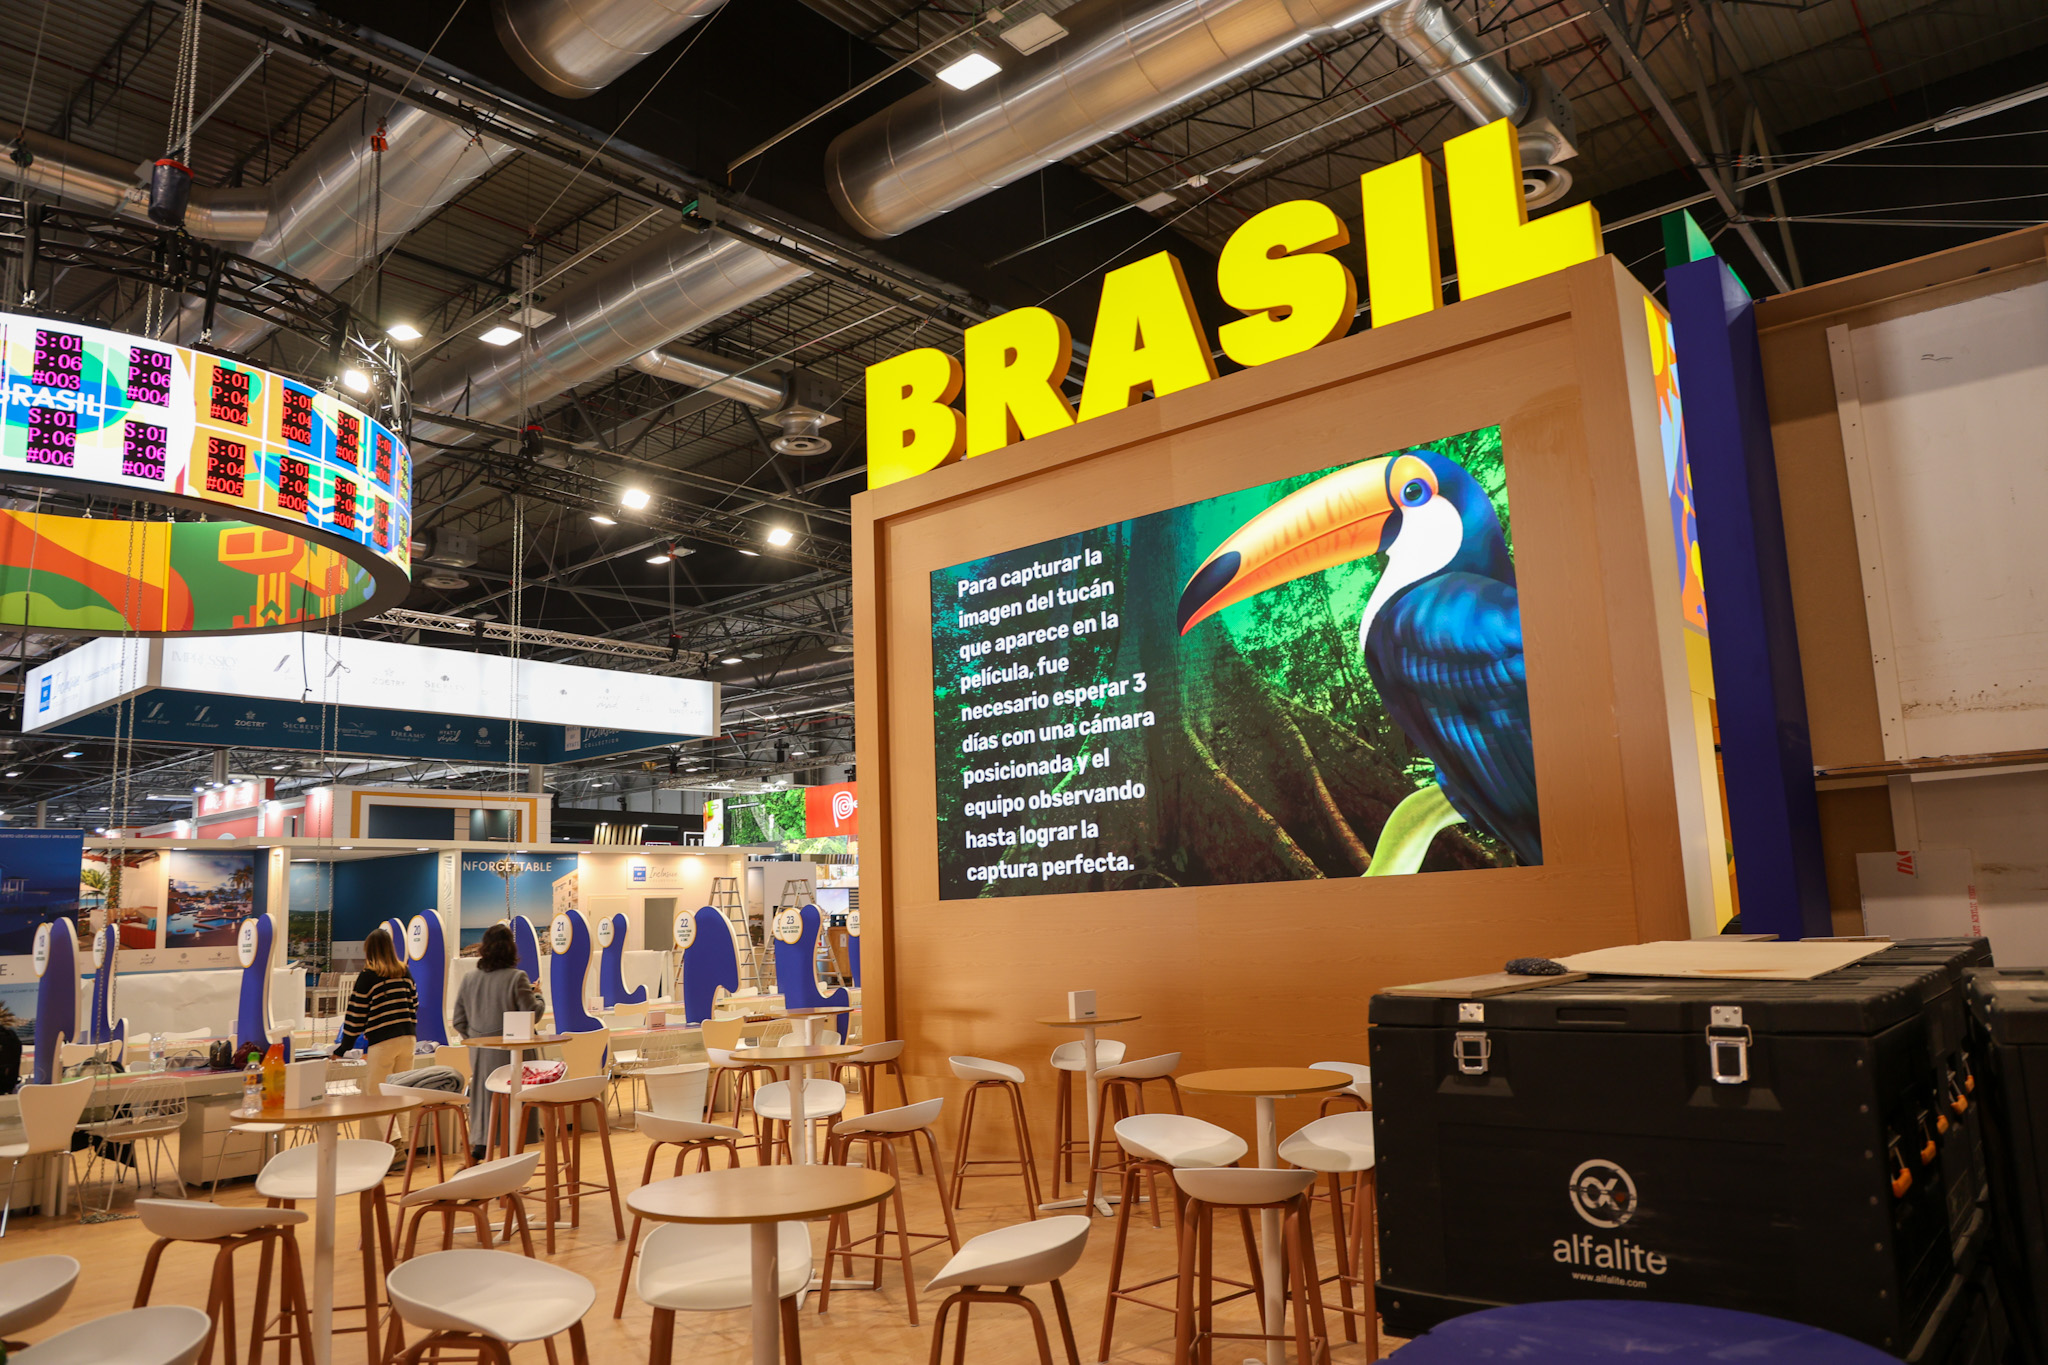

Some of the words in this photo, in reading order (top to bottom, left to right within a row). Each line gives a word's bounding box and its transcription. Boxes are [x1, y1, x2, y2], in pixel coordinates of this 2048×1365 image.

[865, 117, 1602, 490] BRASIL
[35, 331, 82, 352] S:01
[34, 350, 83, 371] P:06
[129, 348, 172, 370] S:01
[32, 369, 81, 390] #003
[128, 366, 171, 388] P:06
[213, 368, 249, 390] S:01
[126, 385, 169, 408] #004
[211, 385, 249, 408] P:04
[283, 389, 312, 411] S:01
[28, 408, 77, 428] S:01
[210, 403, 248, 426] #004
[282, 406, 312, 429] P:04
[337, 411, 360, 433] S:01
[27, 427, 76, 448] P:06
[124, 422, 167, 444] S:01
[281, 423, 311, 446] #003
[336, 429, 359, 450] P:04
[26, 447, 74, 468] #006
[123, 441, 167, 462] P:06
[208, 439, 245, 461] S:01
[335, 445, 358, 466] #002
[122, 460, 165, 481] #005
[207, 457, 245, 479] P:04
[280, 457, 309, 479] S:01
[206, 475, 244, 497] #005
[279, 474, 309, 497] P:04
[335, 477, 357, 498] S:01
[278, 492, 308, 514] #006
[334, 494, 356, 515] P:04
[333, 511, 356, 531] #007
[958, 575, 997, 598] Para
[1000, 554, 1082, 588] capturar
[1085, 548, 1103, 567] la
[958, 601, 1023, 629] imagen
[1026, 591, 1054, 613] del
[1056, 577, 1115, 605] tucán
[959, 640, 992, 663] que
[995, 622, 1069, 655] aparece
[1072, 616, 1097, 636] en
[1101, 611, 1120, 630] la
[960, 664, 1034, 694] película,
[1036, 654, 1070, 676] fue
[961, 690, 1049, 722] necesario
[1052, 677, 1130, 707] esperar
[1132, 672, 1147, 693] 3
[282, 721, 320, 731] SECRETS
[391, 729, 425, 739] DREAMS
[962, 732, 999, 753] días
[1001, 728, 1036, 747] con
[1039, 723, 1075, 742] una
[1078, 710, 1155, 735] cámara
[584, 738, 619, 749] COLLECTION
[963, 754, 1073, 789] posicionada
[1076, 754, 1089, 775] y
[1092, 747, 1110, 767] el
[964, 793, 1025, 820] equipo
[1029, 779, 1146, 811] observando
[965, 826, 1017, 850] hasta
[1020, 823, 1078, 848] lograr
[1081, 819, 1099, 839] la
[966, 859, 1038, 884] captura
[1041, 851, 1135, 881] perfecta.
[680, 919, 688, 928] 22
[786, 915, 795, 925] 23
[852, 915, 858, 923] 10
[1969, 902, 1981, 923] ACRYLIC
[413, 925, 421, 936] 20
[557, 922, 564, 932] 21
[602, 923, 608, 931] 07
[1553, 1233, 1668, 1275] alfalite
[1571, 1271, 1648, 1289] www.alfalite.com
